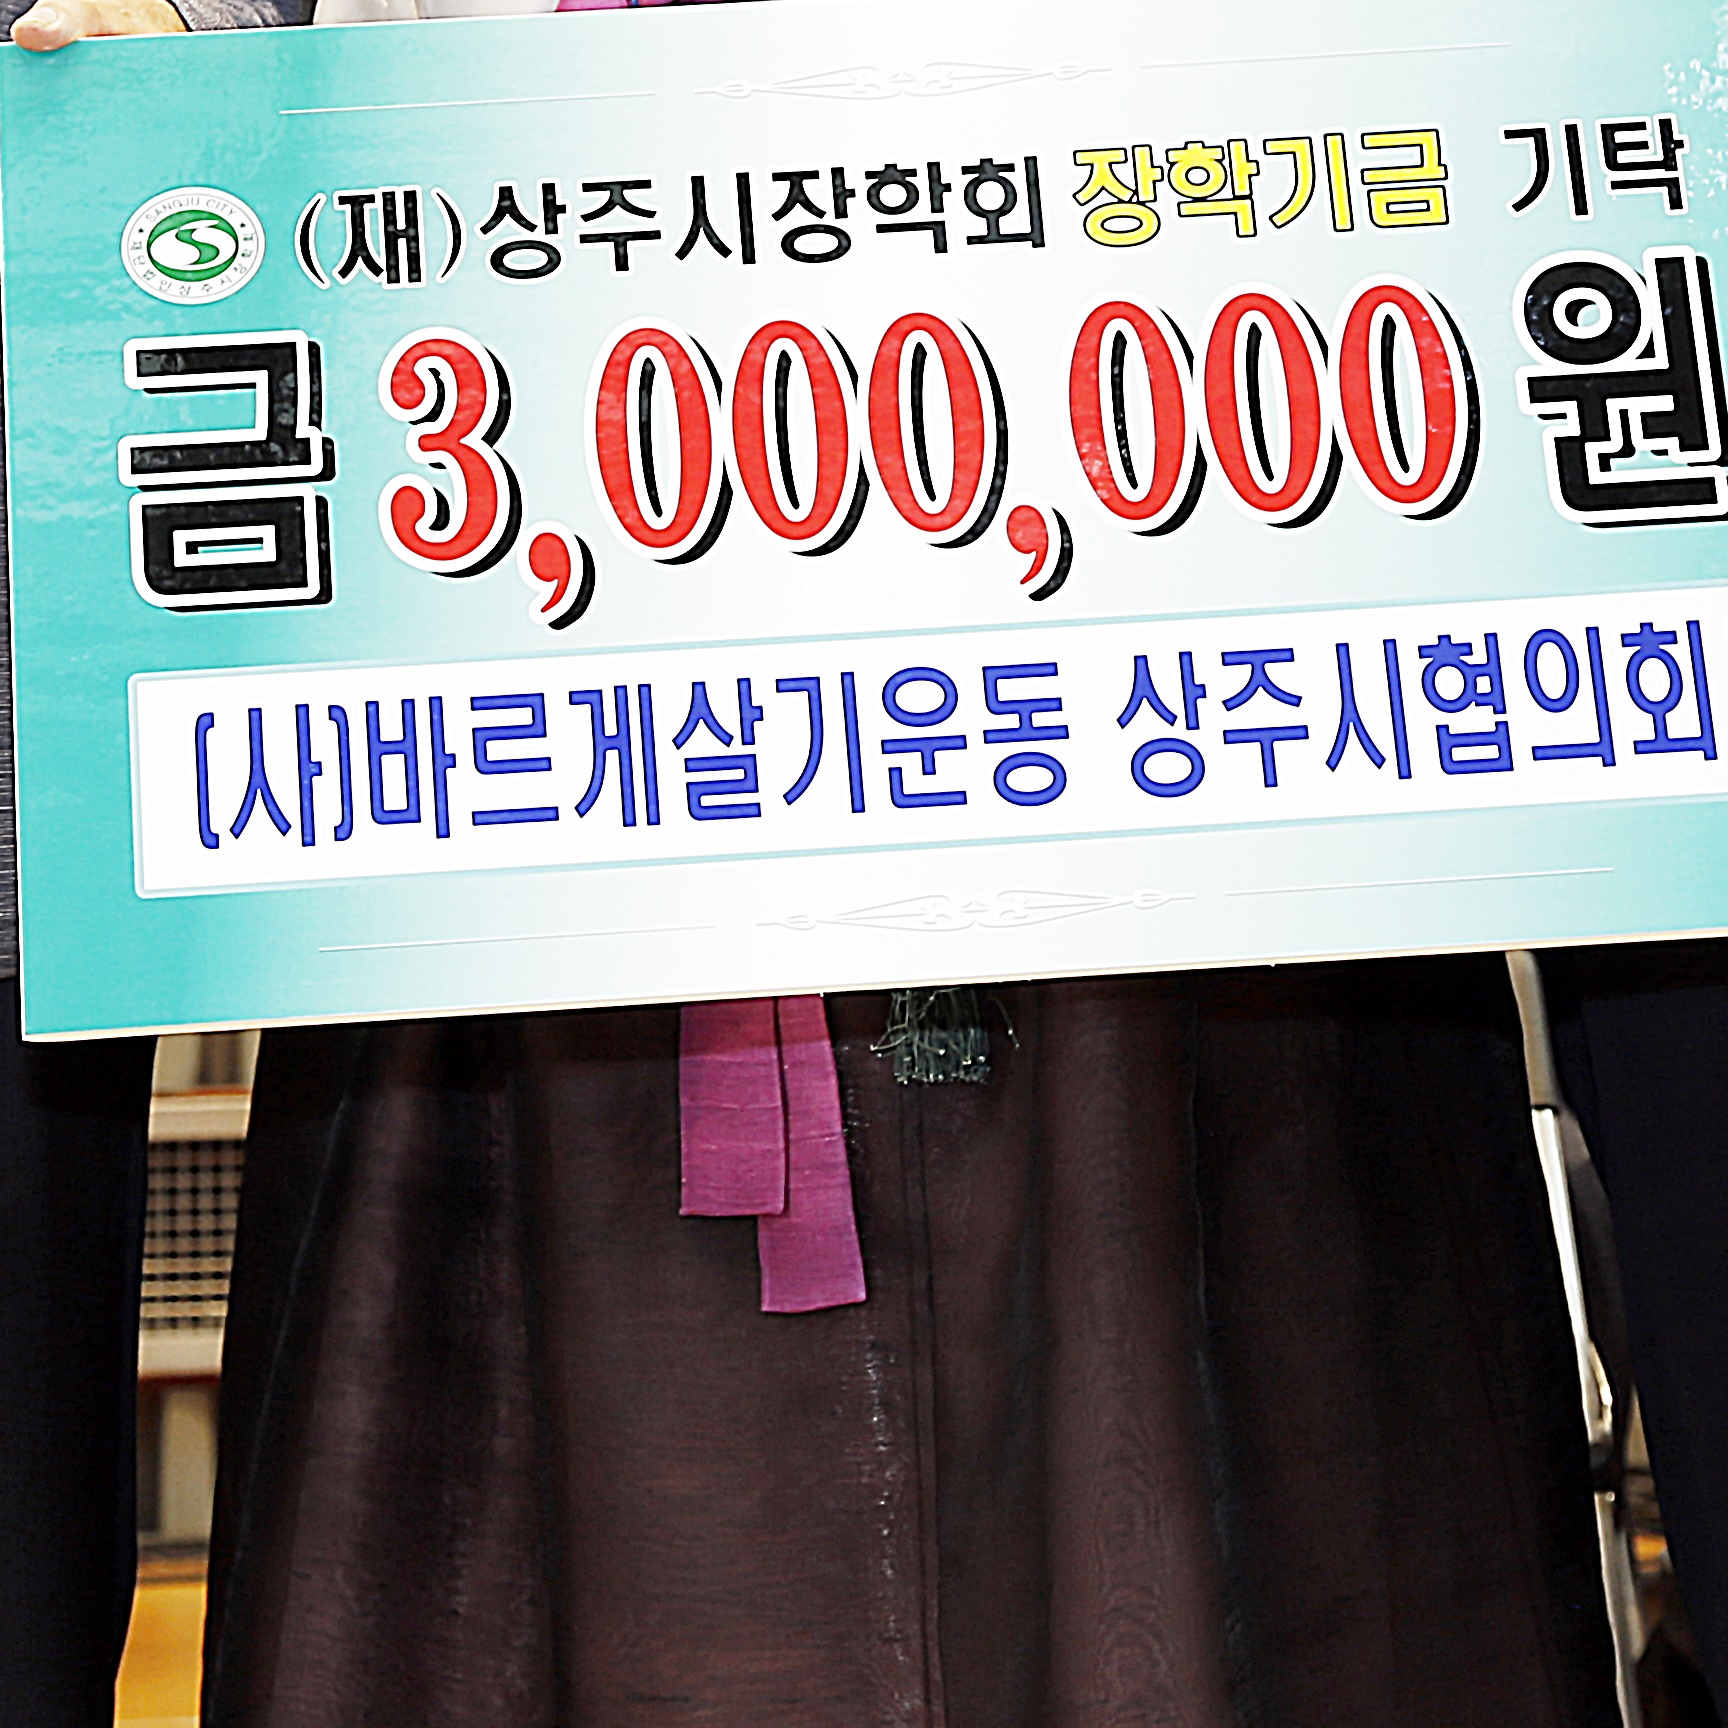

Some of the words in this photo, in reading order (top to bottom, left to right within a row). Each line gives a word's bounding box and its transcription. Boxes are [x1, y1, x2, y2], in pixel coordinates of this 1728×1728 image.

[146, 197, 200, 222] SANGJU
[206, 198, 237, 216] CITY
[298, 156, 1046, 285] (재)상주시장학회
[1072, 129, 1450, 248] 장학기금
[1503, 119, 1685, 216] 기탁
[130, 341, 336, 613] 금
[390, 283, 1476, 624] 3,000,000
[1119, 619, 1716, 798] 상주시협의회
